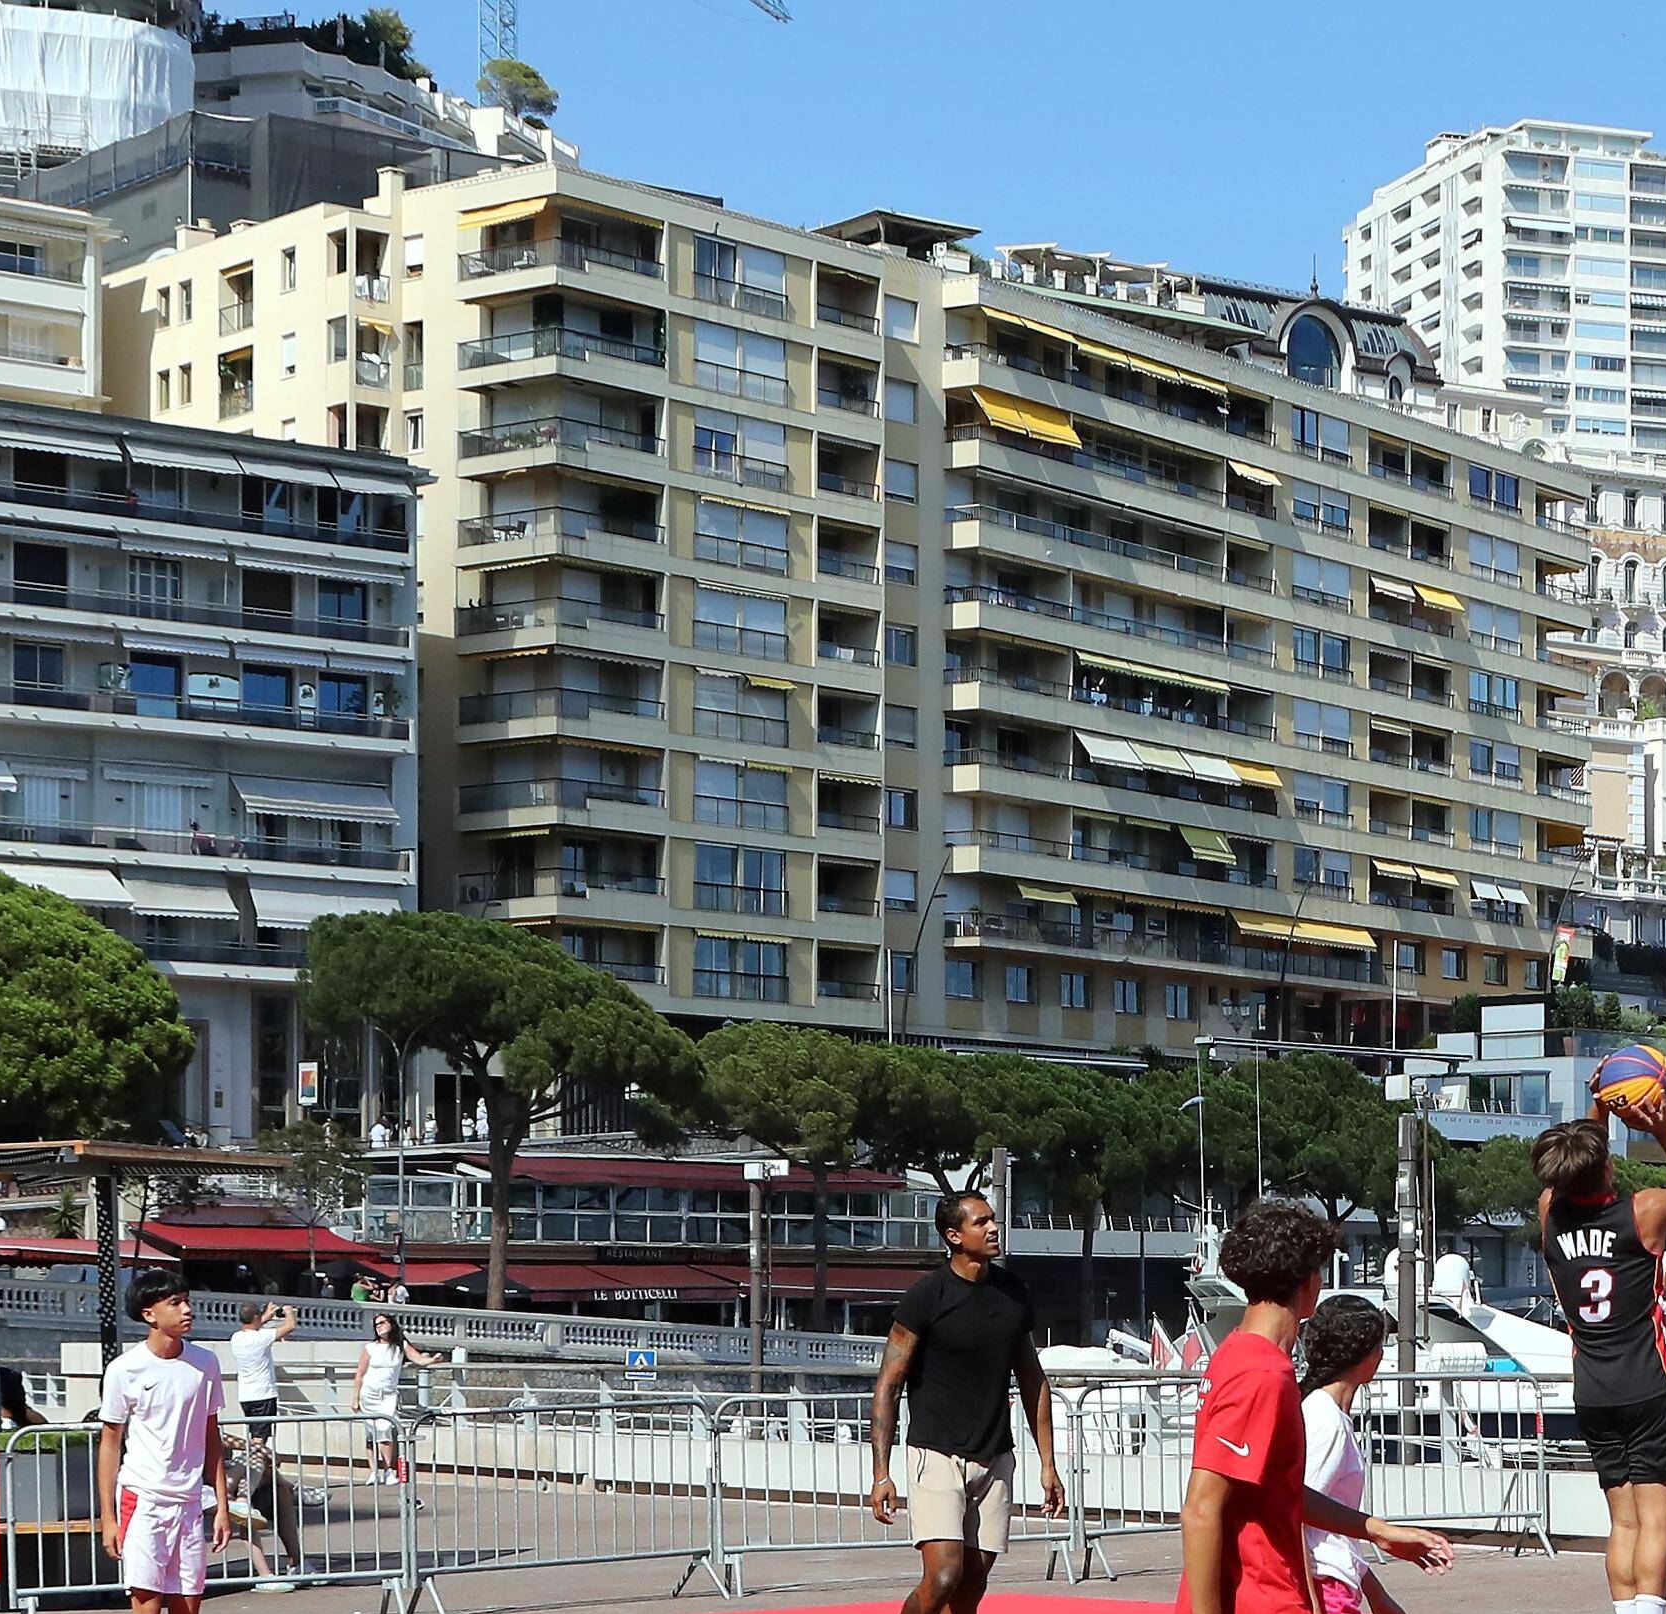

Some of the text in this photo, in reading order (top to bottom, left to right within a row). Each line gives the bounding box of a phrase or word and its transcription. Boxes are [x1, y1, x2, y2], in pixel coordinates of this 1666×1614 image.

[1556, 1229, 1617, 1261] WADE
[594, 1288, 678, 1301] LE BOTTICELLI
[1579, 1270, 1612, 1323] 3
